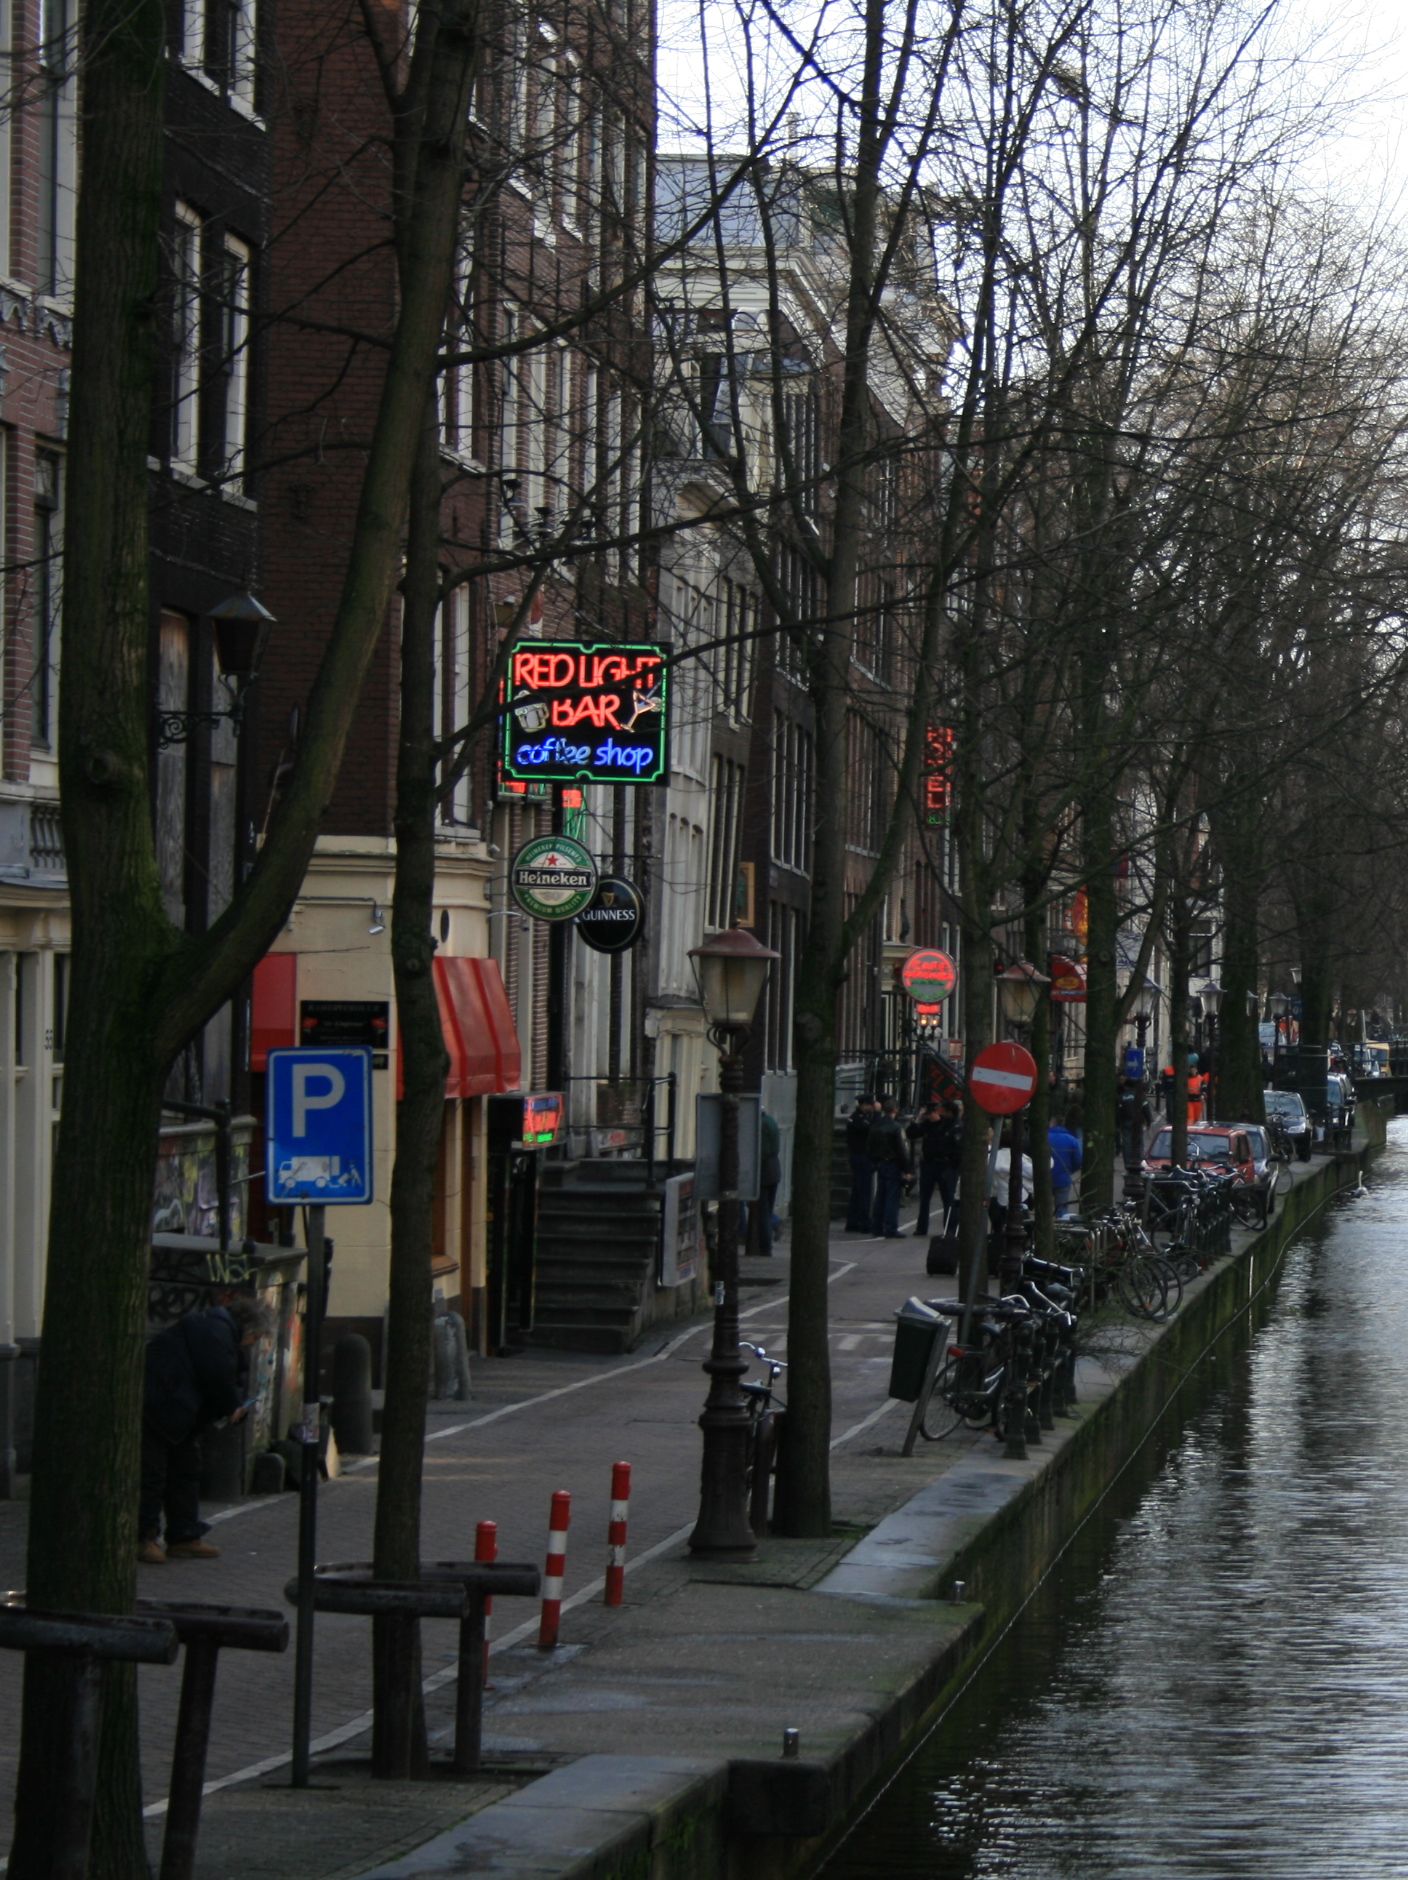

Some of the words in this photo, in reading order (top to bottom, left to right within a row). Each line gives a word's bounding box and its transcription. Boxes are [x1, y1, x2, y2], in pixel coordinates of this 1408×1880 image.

[514, 653, 574, 689] RED
[580, 655, 661, 689] LIGHT
[552, 694, 624, 730] BAR
[517, 737, 590, 766] coffee
[594, 738, 654, 775] shop
[518, 871, 588, 886] Heineken
[582, 909, 636, 921] GUINNESS
[292, 1063, 346, 1138] P
